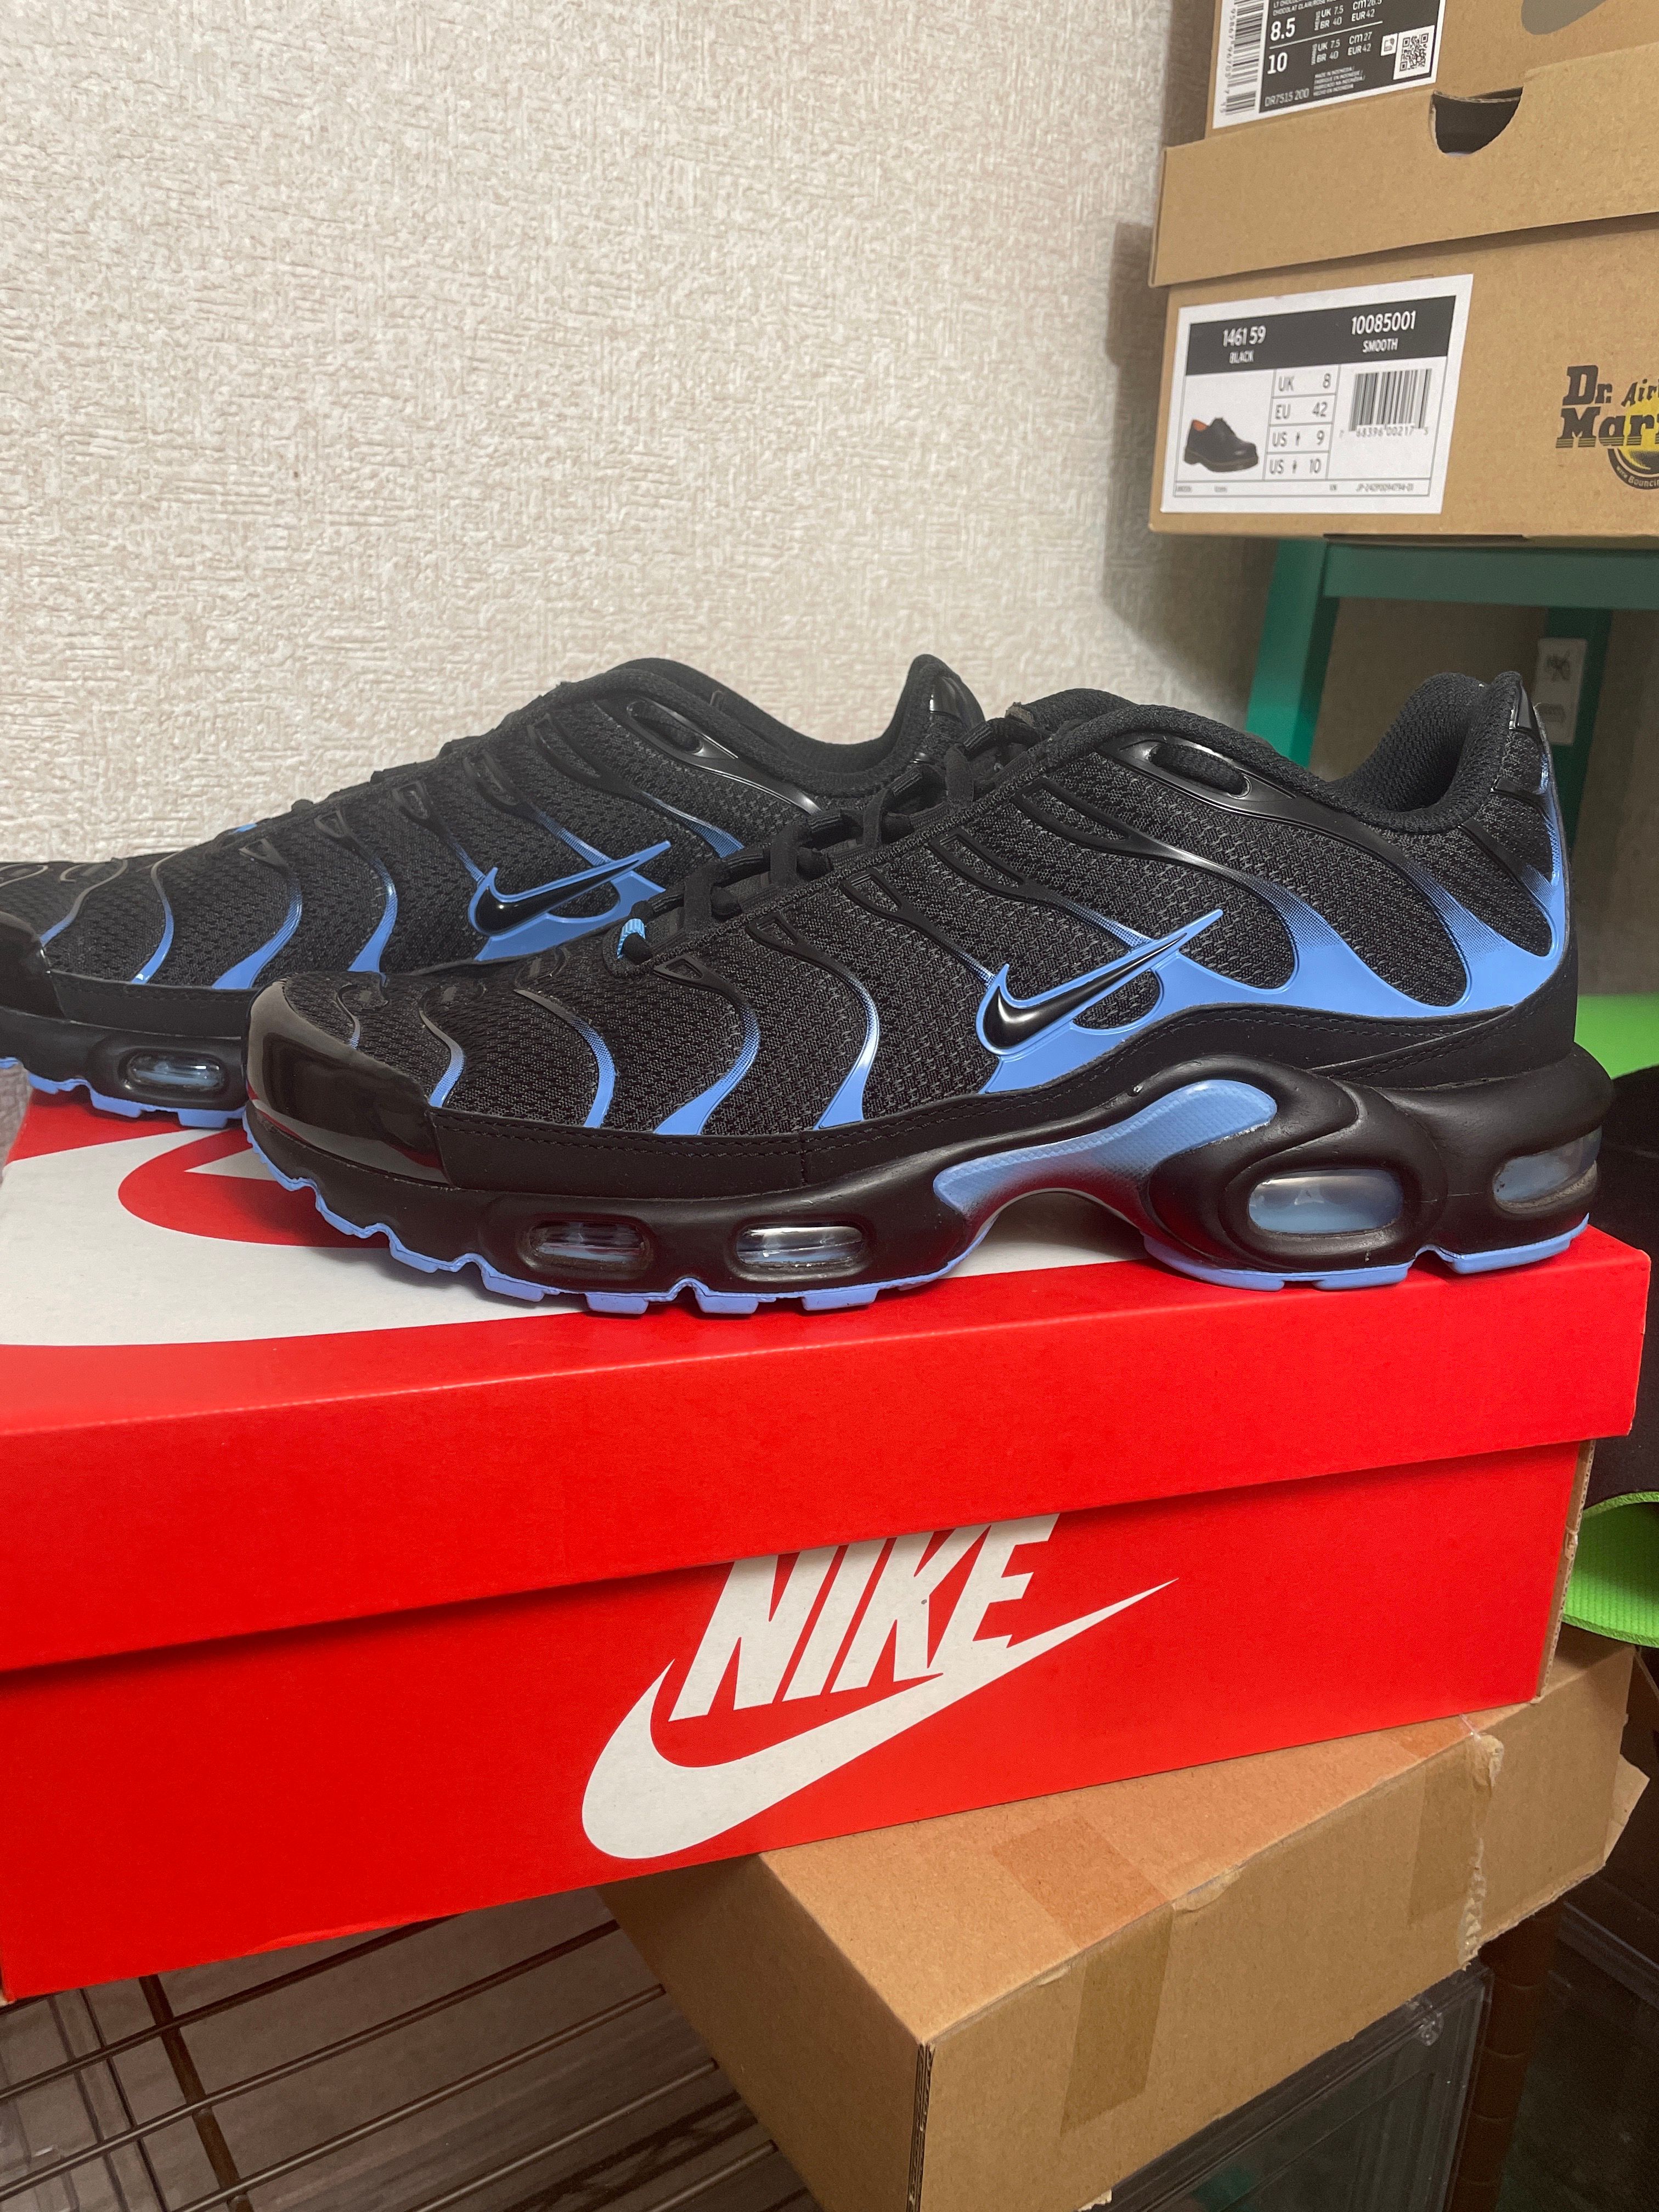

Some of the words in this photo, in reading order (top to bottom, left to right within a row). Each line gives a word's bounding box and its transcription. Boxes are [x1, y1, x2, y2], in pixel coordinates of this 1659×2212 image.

[1321, 8, 1331, 18] UK
[1334, 5, 1344, 15] 7.5
[1351, 11, 1365, 21] EUR
[1366, 8, 1375, 18] 42
[1270, 17, 1296, 41] 8.5
[1319, 20, 1330, 29] BR
[1333, 16, 1342, 25] 40
[1348, 33, 1363, 44] cm
[1363, 31, 1373, 42] 27
[1318, 43, 1328, 52] UK
[1330, 40, 1340, 48] 7.5
[1347, 45, 1362, 55] EUR
[1362, 43, 1372, 52] 42
[1329, 50, 1339, 59] 40
[1267, 52, 1288, 74] 10
[1351, 310, 1416, 335] 10085001
[1223, 328, 1248, 347] 1461
[1249, 325, 1266, 345] 59
[1362, 338, 1398, 353] SMOOTH
[1229, 350, 1254, 364] BLACK
[1278, 376, 1295, 392] UK
[1322, 373, 1331, 388] 8
[1562, 365, 1612, 406] Dr.
[1621, 379, 1659, 407] Air
[1275, 404, 1291, 420] EU
[1312, 402, 1328, 417] 42
[1272, 431, 1288, 447] US
[1316, 430, 1325, 445] 9
[1269, 459, 1284, 475] US
[1309, 459, 1322, 474] 10
[668, 1513, 1061, 1722] NIKE
